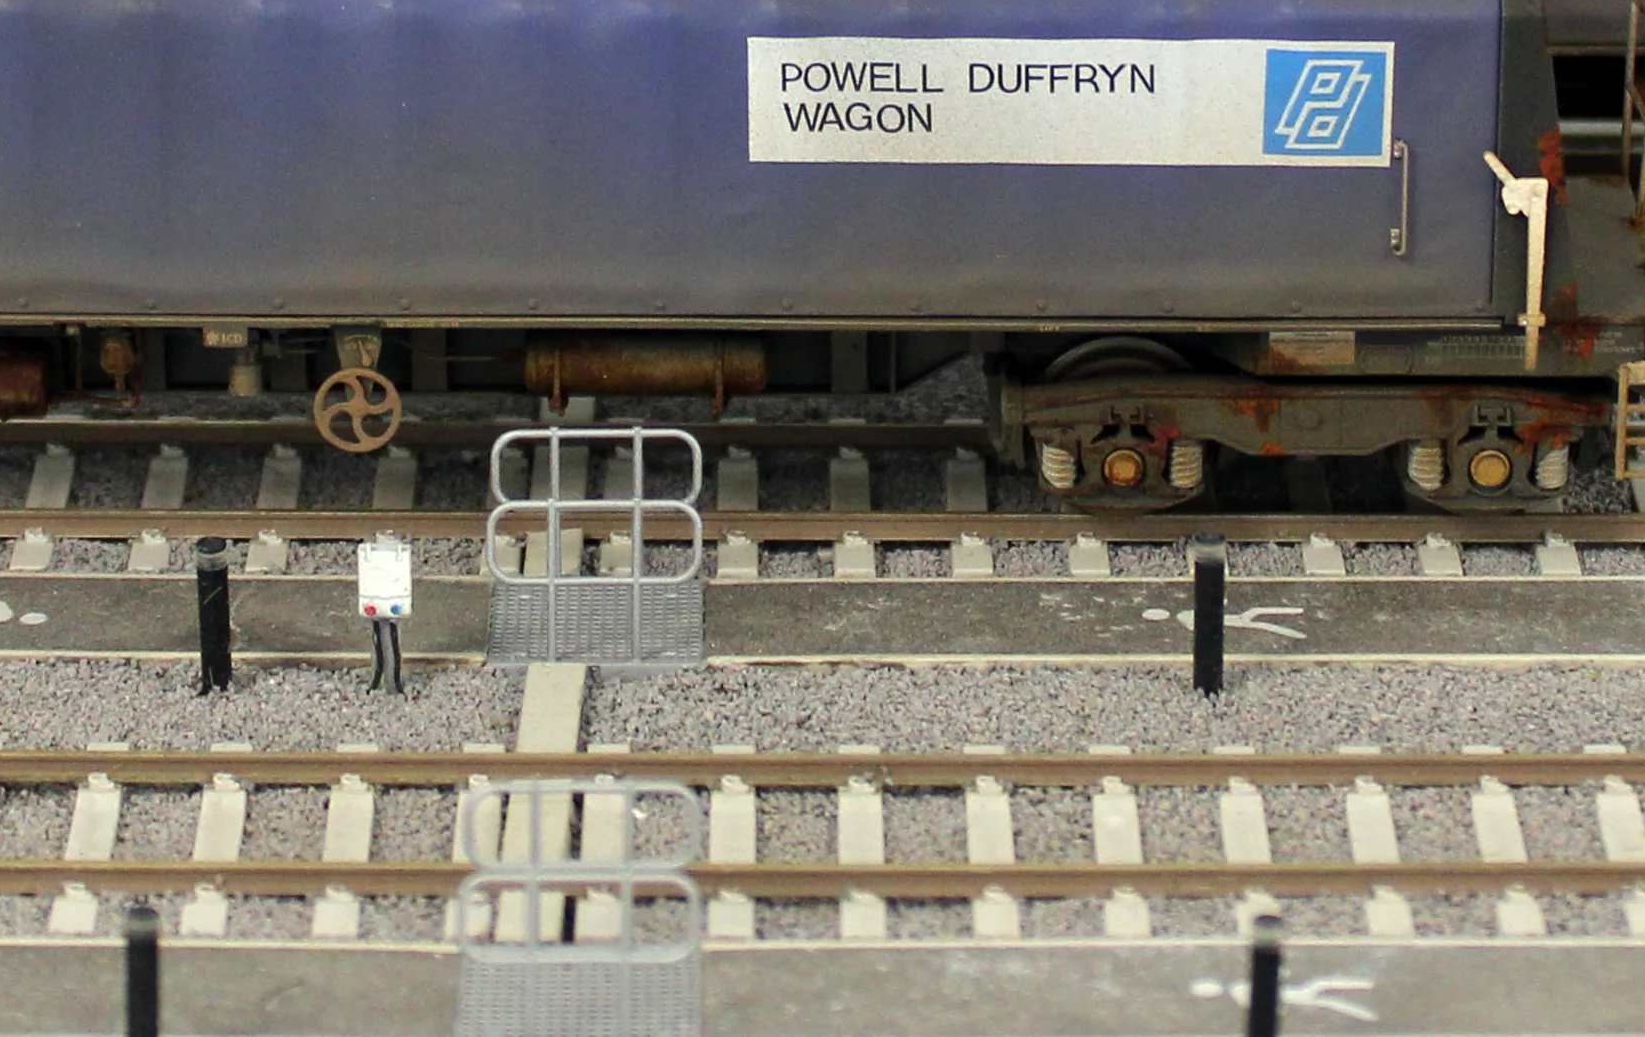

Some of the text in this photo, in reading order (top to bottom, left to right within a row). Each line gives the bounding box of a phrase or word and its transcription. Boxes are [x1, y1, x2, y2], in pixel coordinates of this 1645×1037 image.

[781, 61, 1155, 94] POWELL DUFFRYN
[783, 102, 932, 134] WAGON
